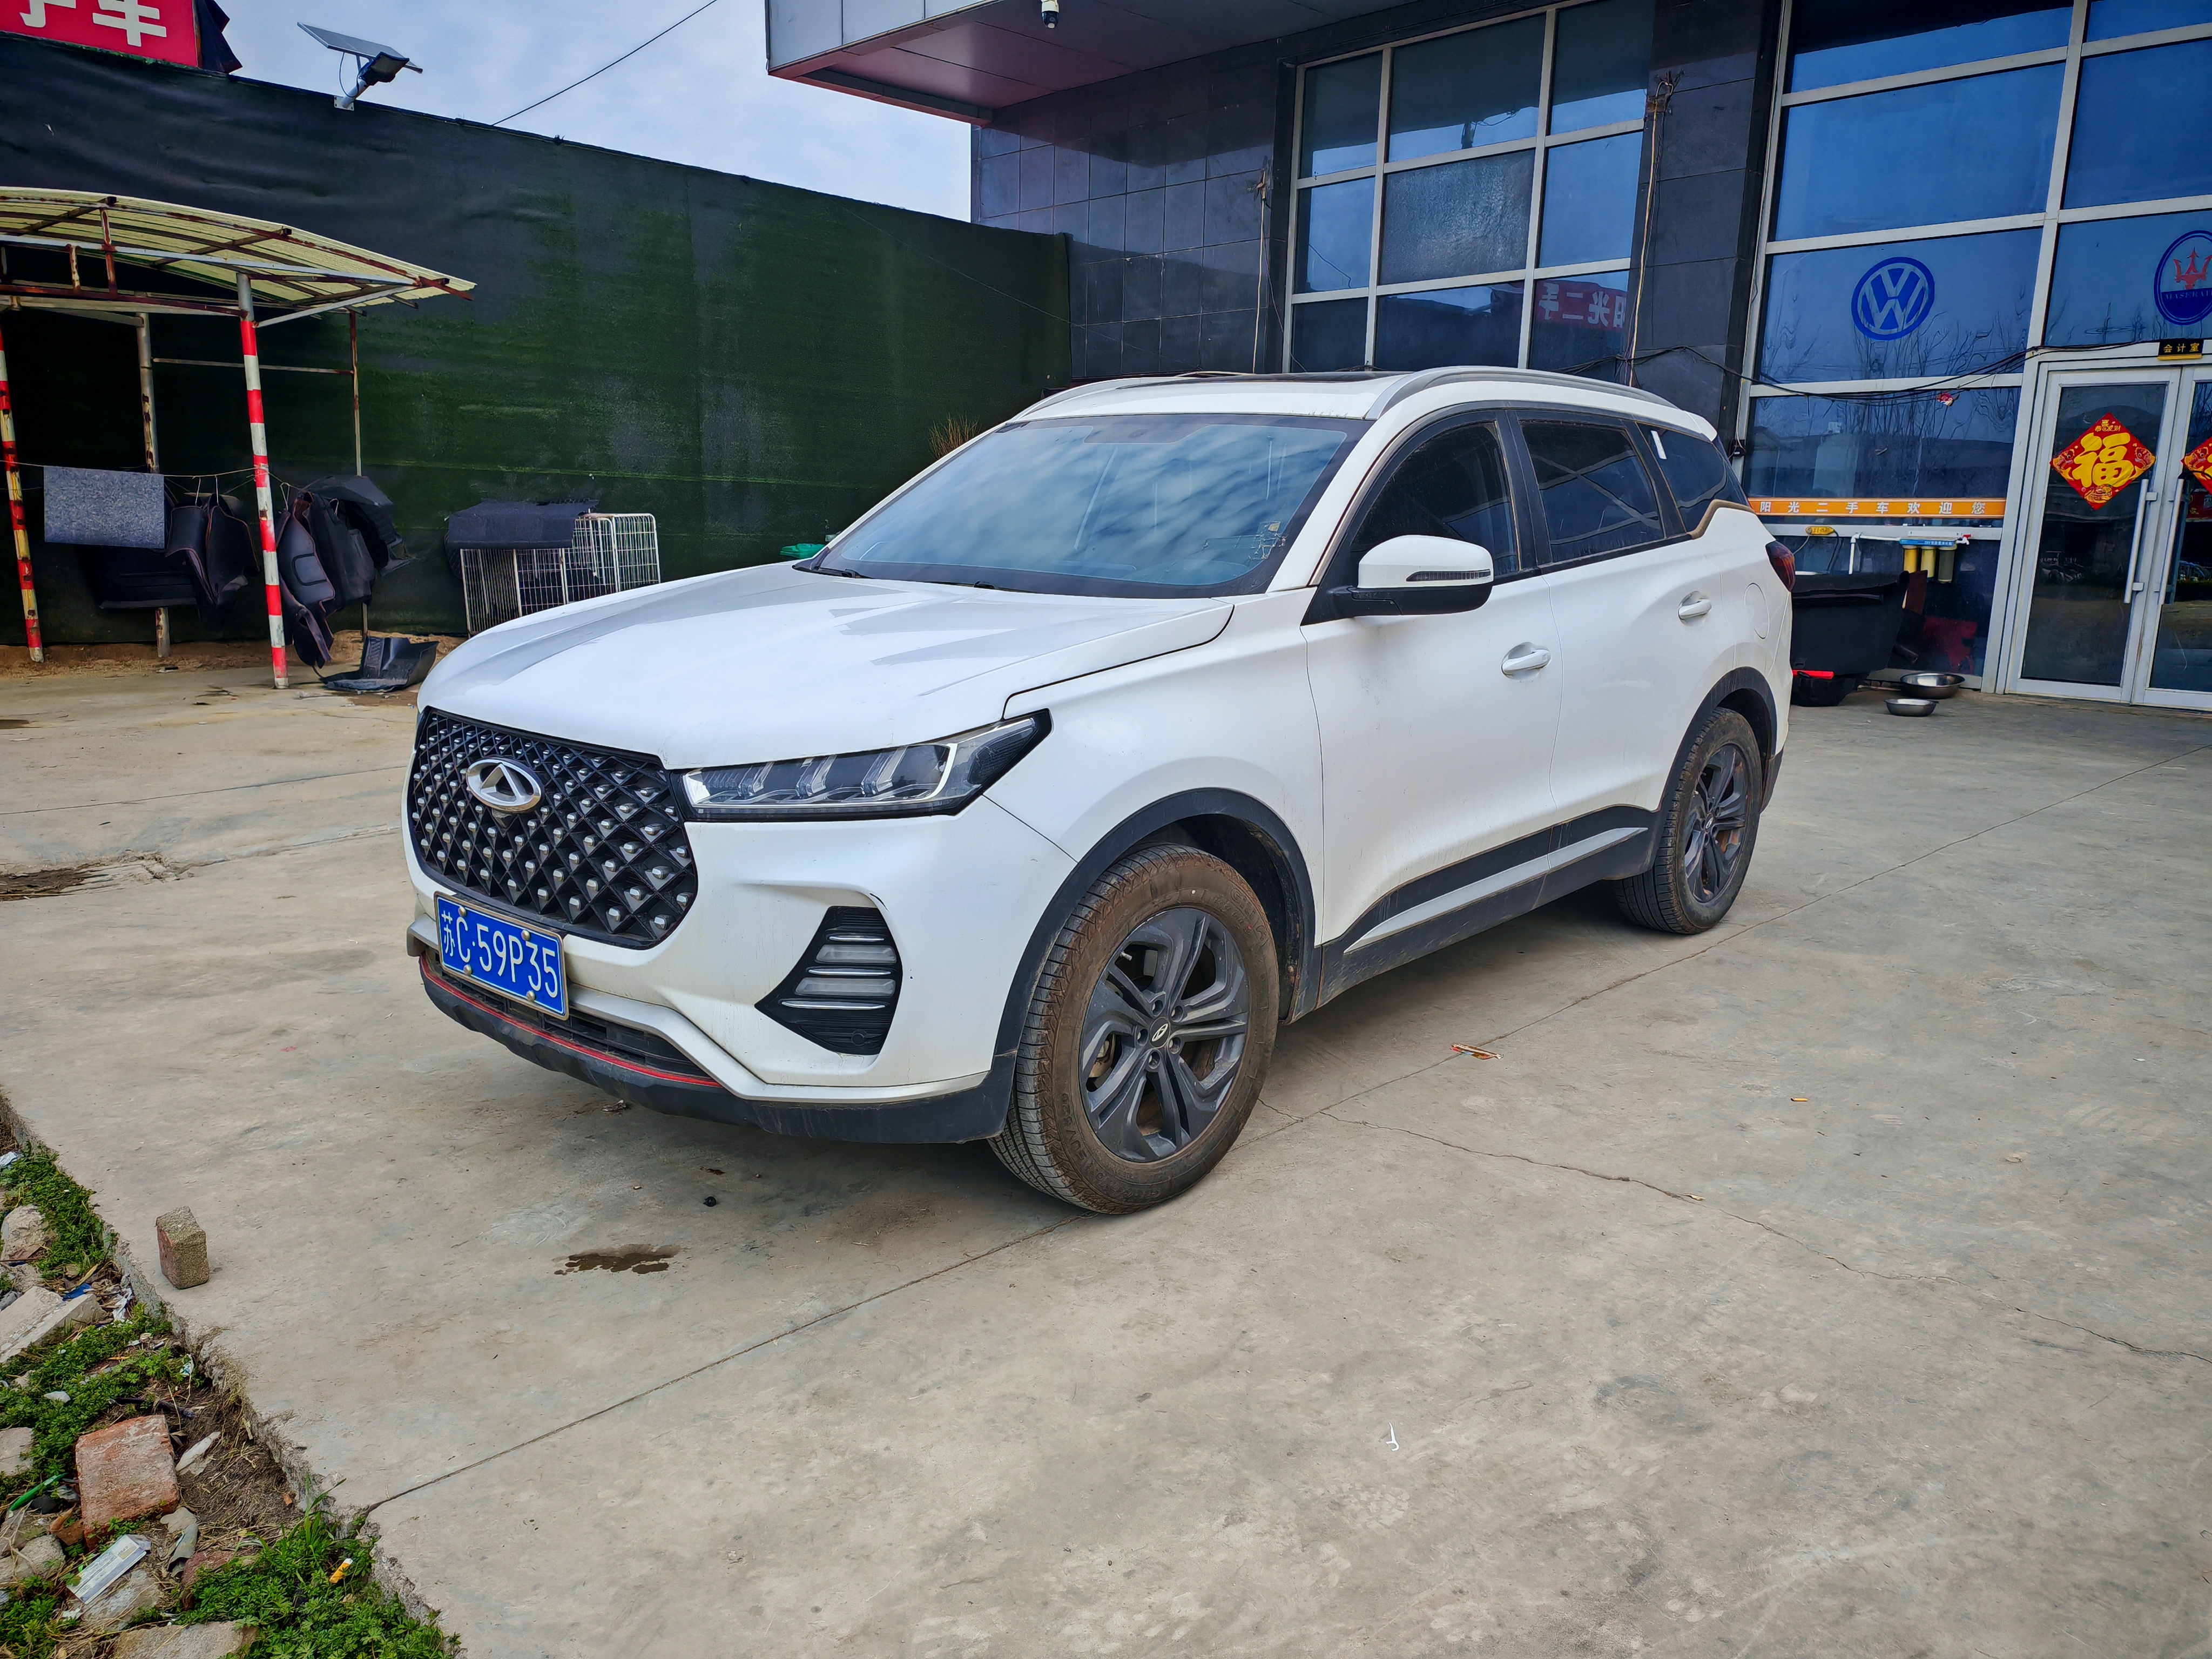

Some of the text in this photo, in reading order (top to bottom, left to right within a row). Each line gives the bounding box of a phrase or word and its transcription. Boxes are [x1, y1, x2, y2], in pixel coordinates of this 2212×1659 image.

[2163, 342, 2200, 353] 会计室
[2072, 432, 2131, 488] 福
[1759, 501, 1986, 514] 阳光二手车欢迎您
